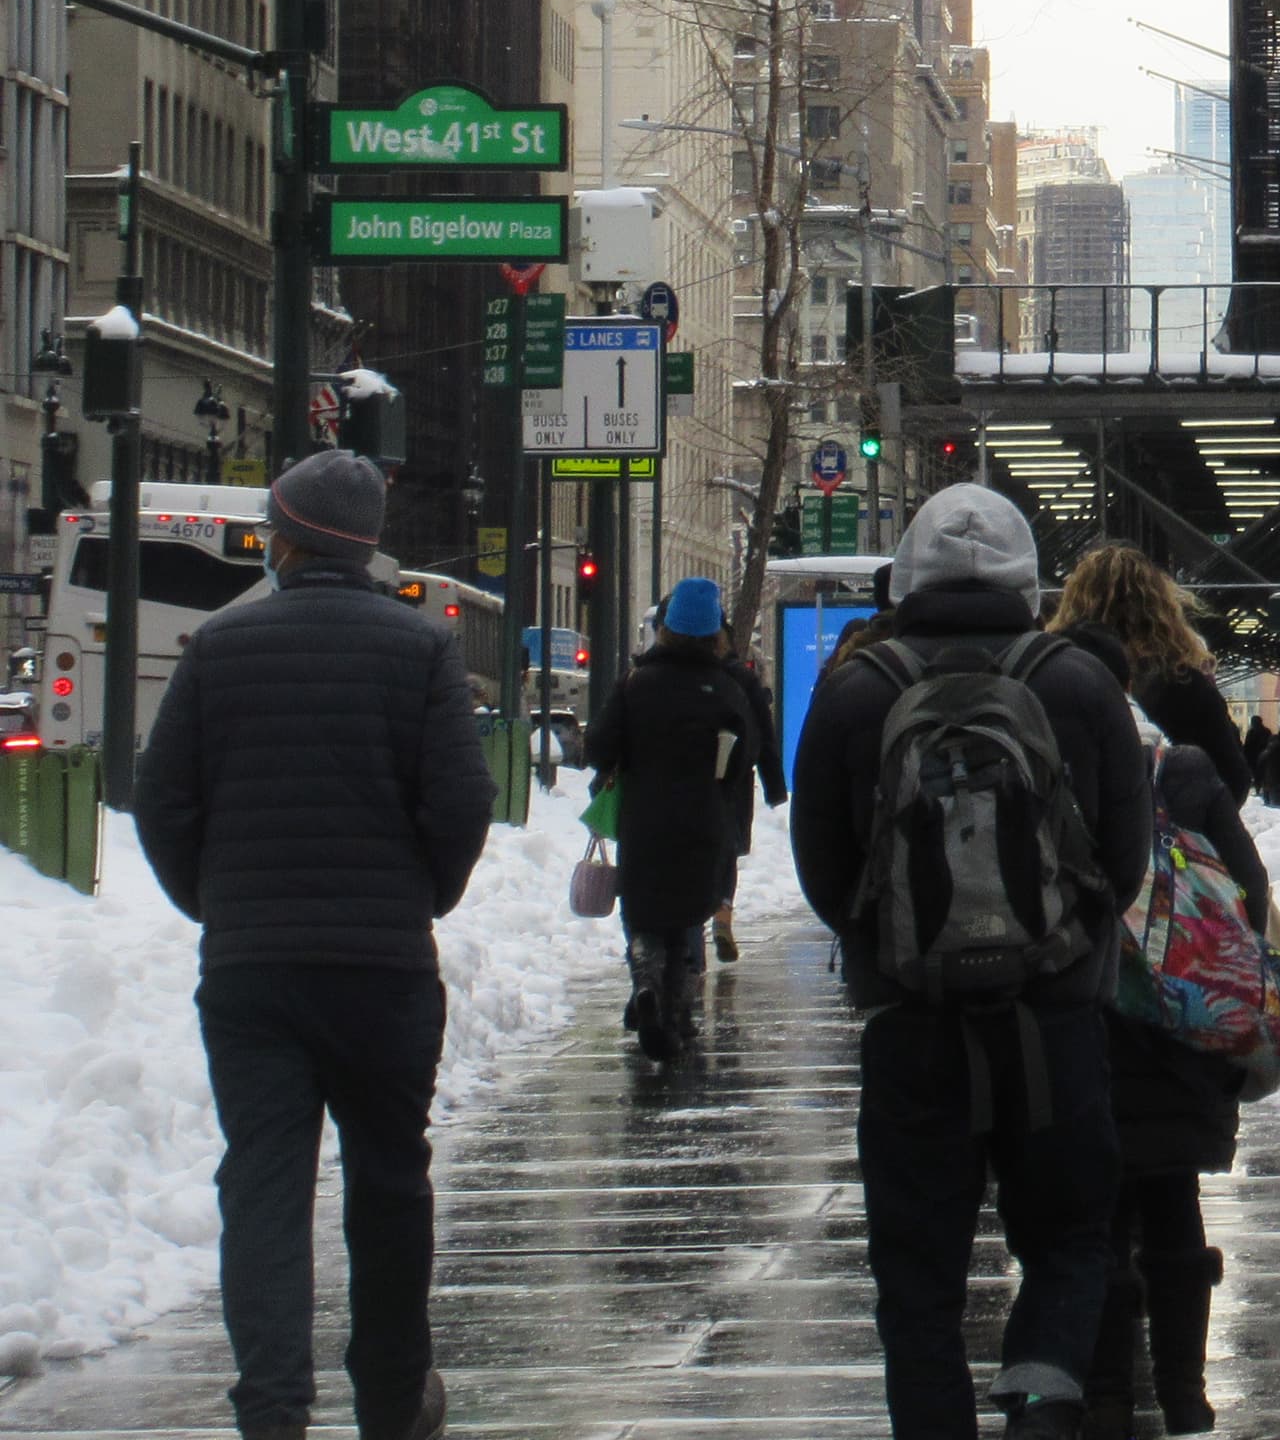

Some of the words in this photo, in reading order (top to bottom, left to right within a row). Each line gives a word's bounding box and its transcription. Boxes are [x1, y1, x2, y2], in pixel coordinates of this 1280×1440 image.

[347, 122, 432, 154] West
[442, 121, 501, 154] 41st
[511, 122, 545, 155] St
[347, 215, 402, 240] John
[409, 216, 503, 246] Bigelow
[508, 221, 552, 240] Plaza
[487, 298, 509, 315] x27
[580, 332, 624, 347] LANES
[485, 344, 508, 361] x37
[533, 414, 568, 427] BUSES
[604, 413, 639, 427] BUSES
[536, 431, 565, 445] ONLY
[607, 431, 636, 444] ONLY
[170, 523, 215, 540] 4670
